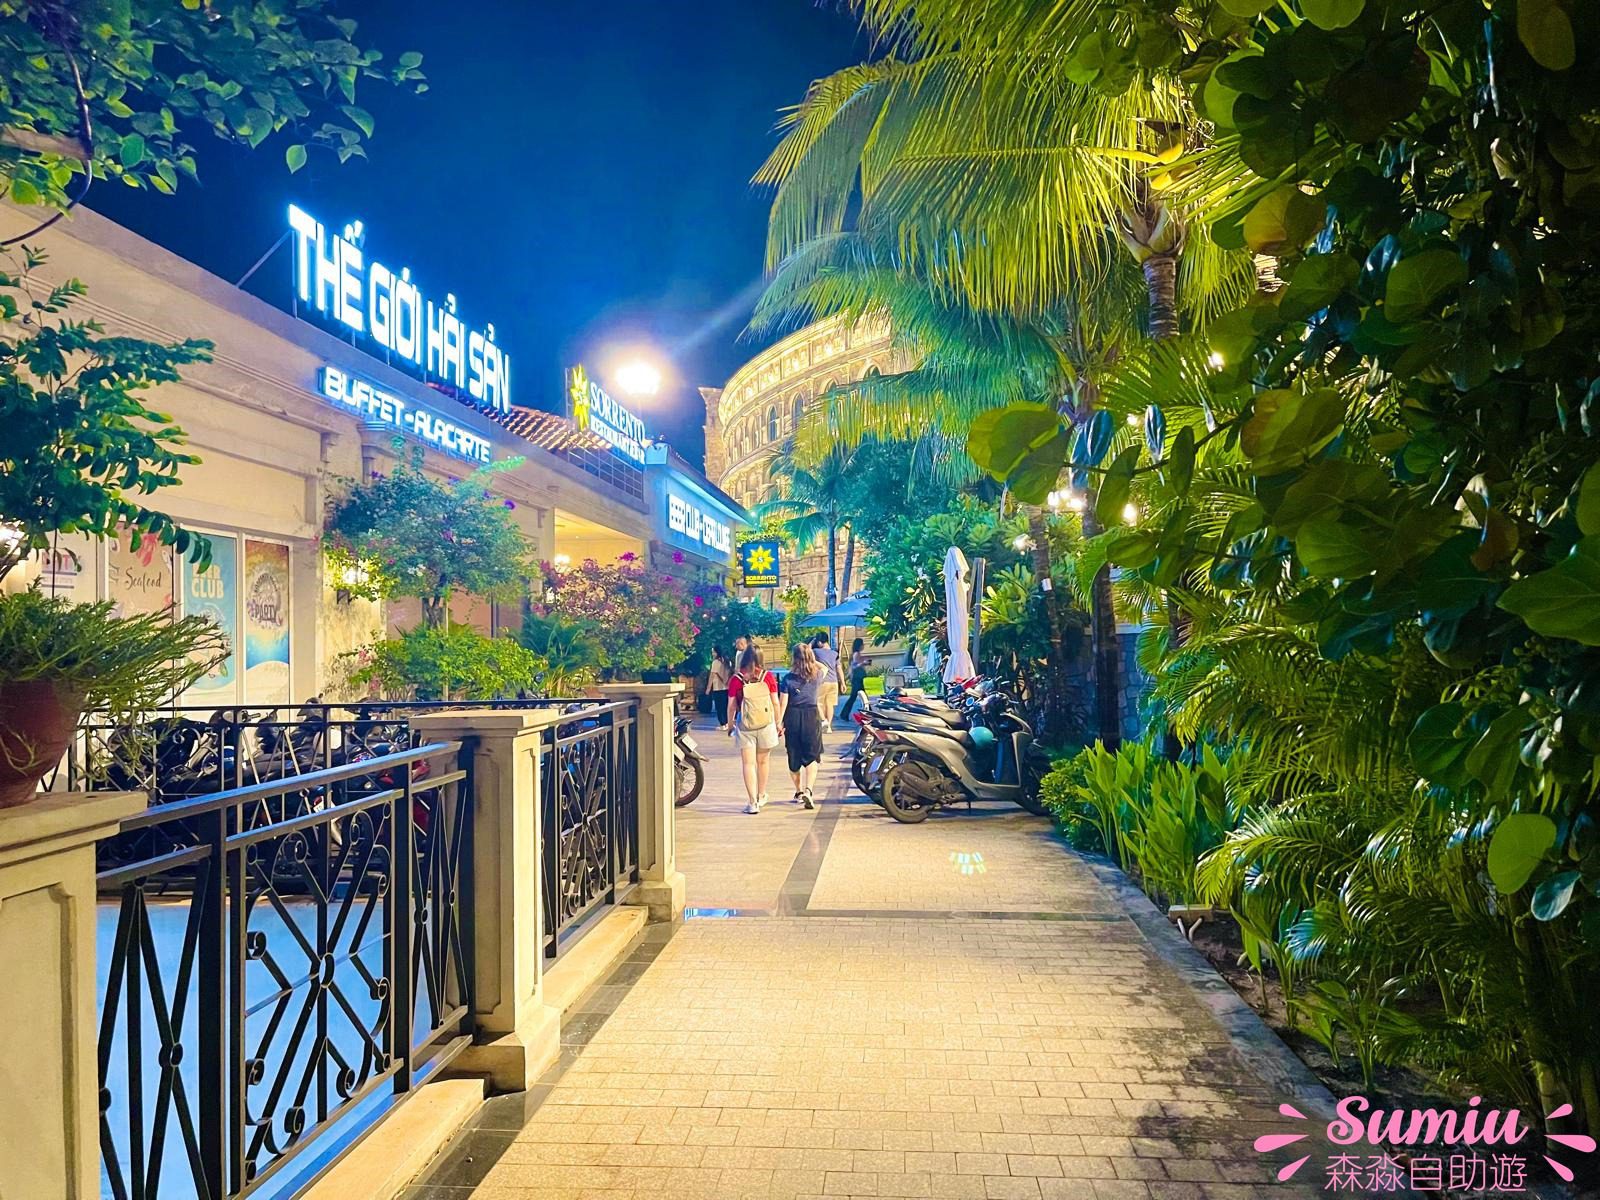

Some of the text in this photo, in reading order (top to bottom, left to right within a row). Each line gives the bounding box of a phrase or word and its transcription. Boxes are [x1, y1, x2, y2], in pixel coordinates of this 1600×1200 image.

[289, 203, 510, 414] THẾ GIỚI HẢI SẢN
[590, 381, 646, 444] SORRENTO
[191, 579, 224, 599] CLUB
